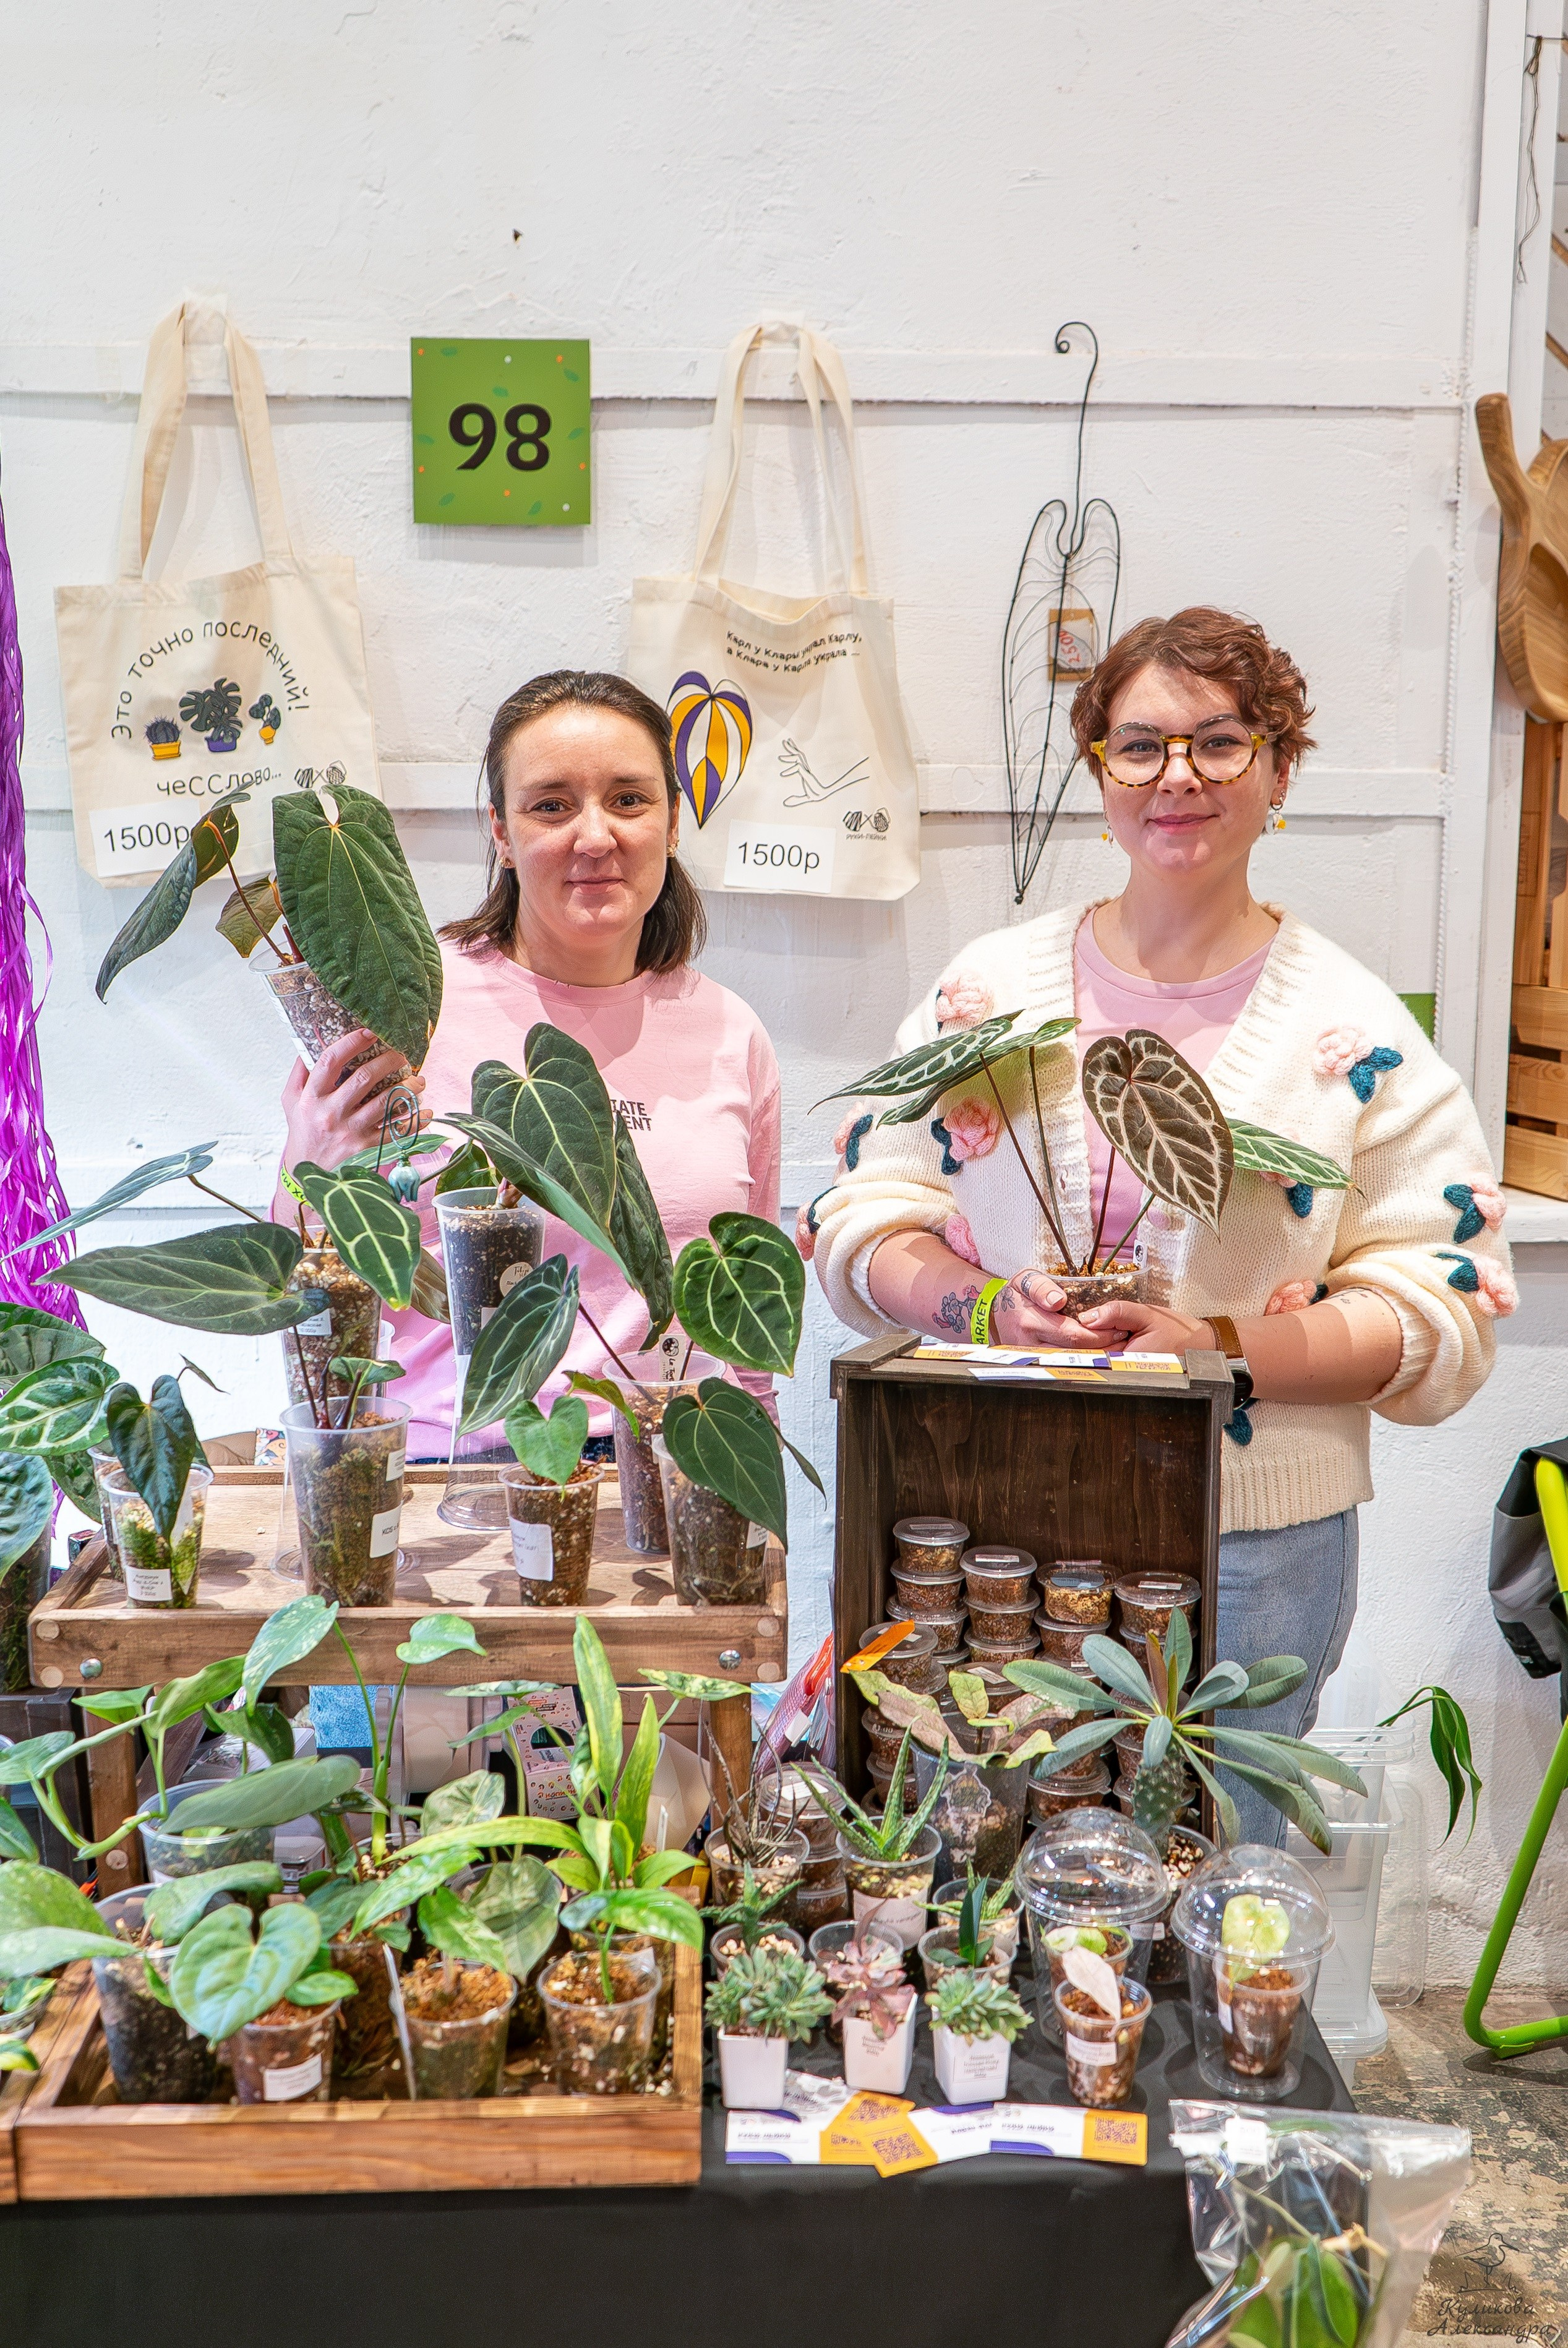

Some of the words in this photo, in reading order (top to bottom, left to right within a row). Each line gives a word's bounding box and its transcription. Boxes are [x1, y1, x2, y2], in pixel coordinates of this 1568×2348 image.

[449, 403, 551, 471] 98
[111, 690, 132, 739] Это
[128, 627, 193, 679] точно
[203, 621, 309, 711] последний!
[104, 822, 190, 852] 1500р
[739, 842, 820, 874] 1500р
